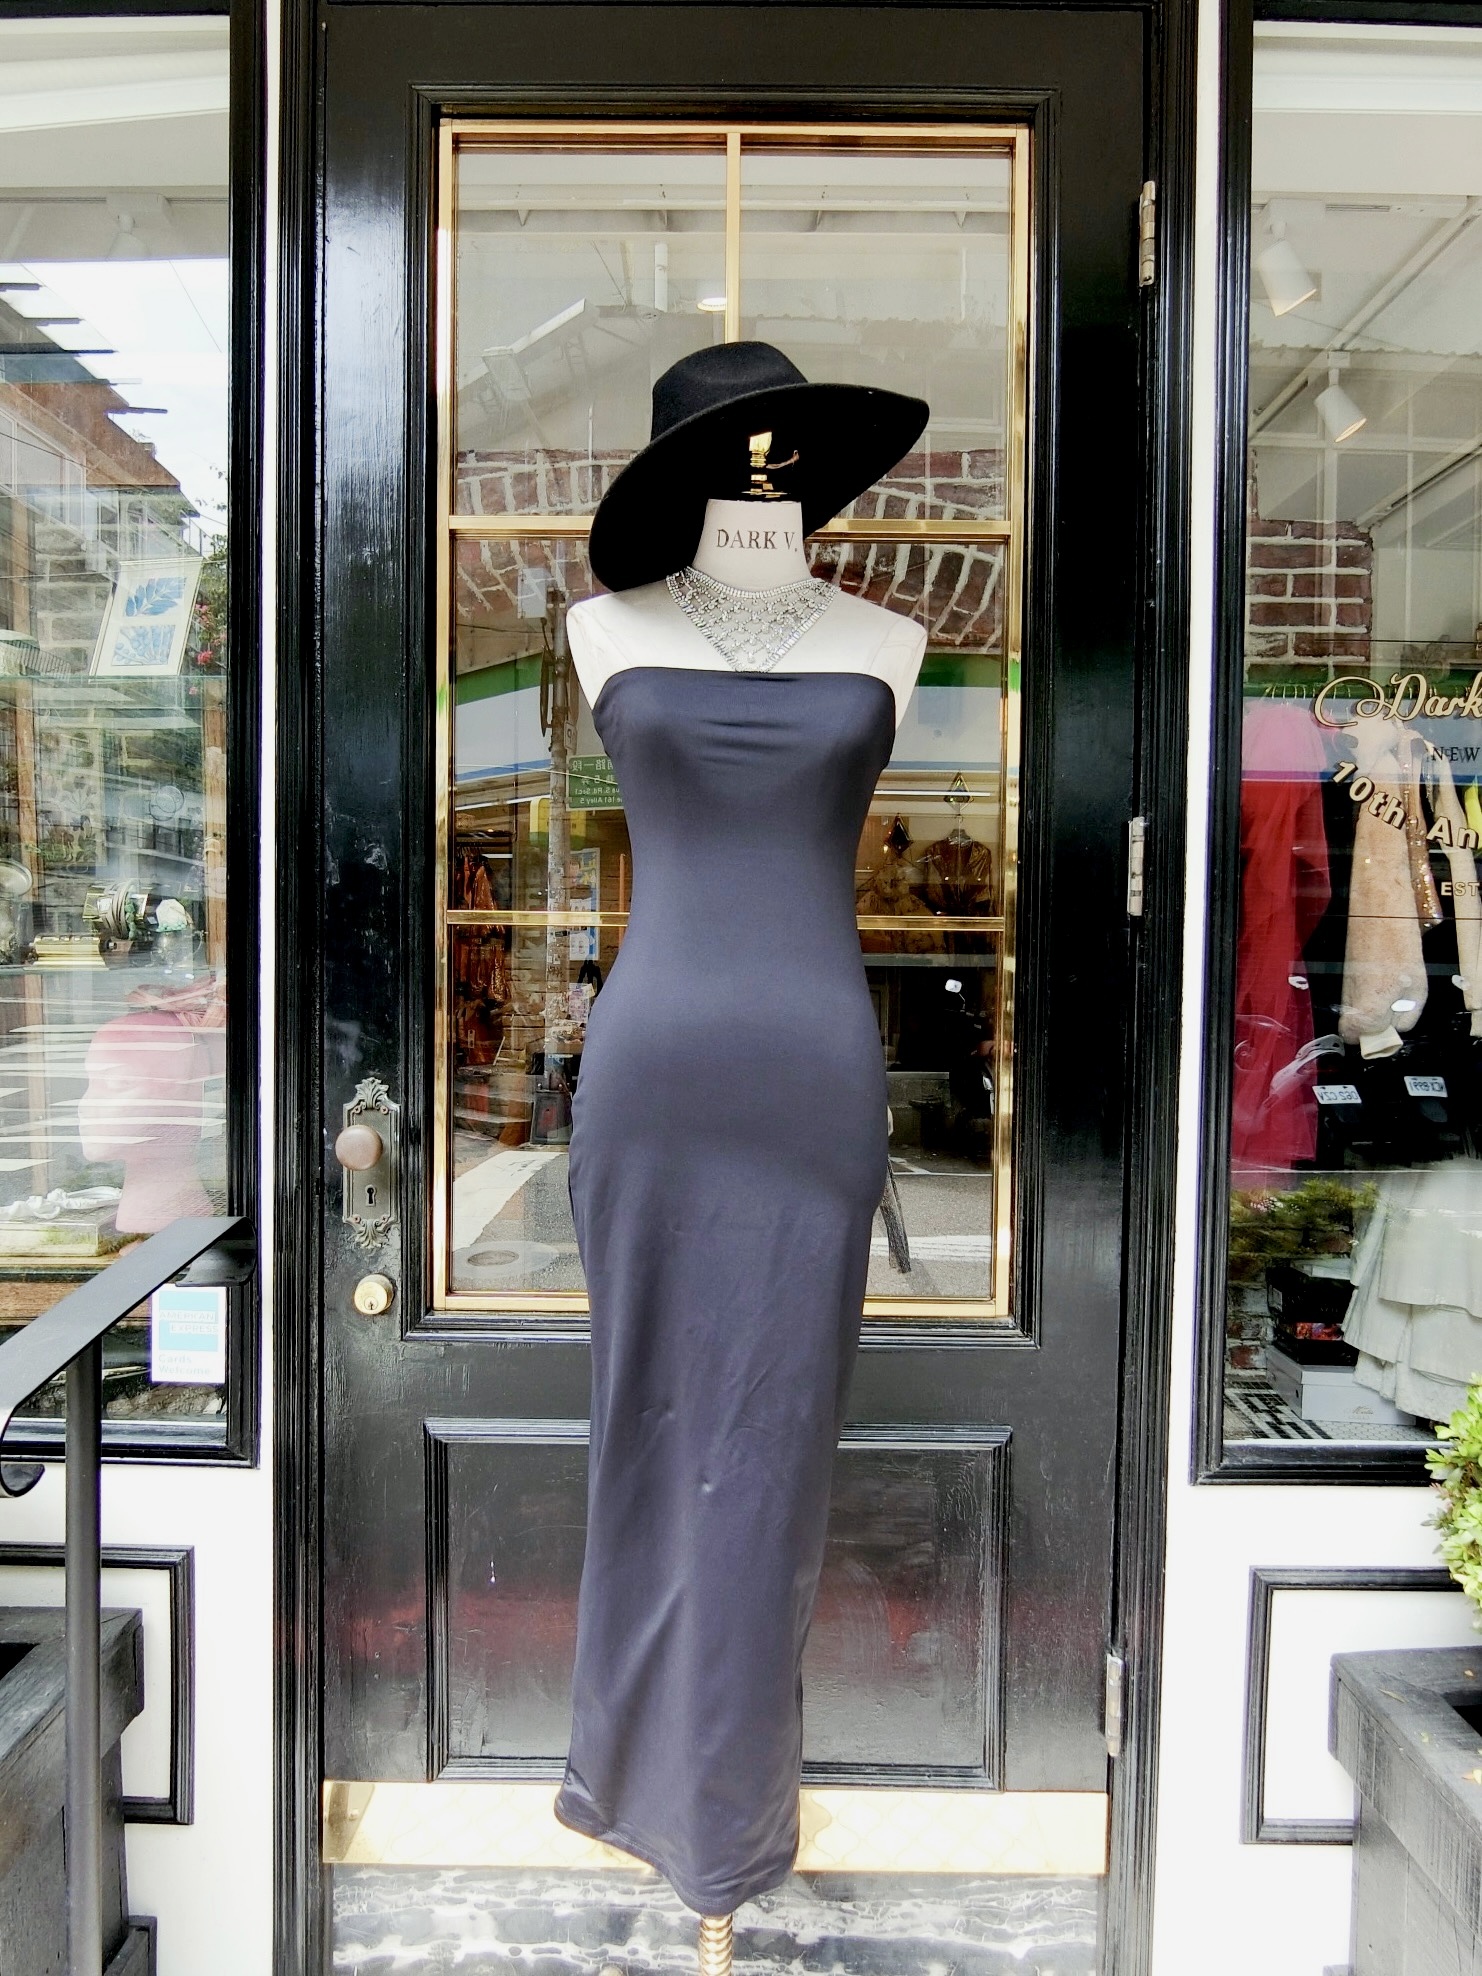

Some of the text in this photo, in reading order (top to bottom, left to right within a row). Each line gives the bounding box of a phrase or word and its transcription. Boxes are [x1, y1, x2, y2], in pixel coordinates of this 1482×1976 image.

[716, 528, 778, 549] DARK
[1431, 746, 1481, 762] NEW
[1332, 760, 1408, 830] 10th
[159, 1311, 215, 1321] AMERICAN
[171, 1323, 219, 1333] EXPRESS
[158, 1353, 192, 1364] Cards
[159, 1365, 210, 1375] Welcome
